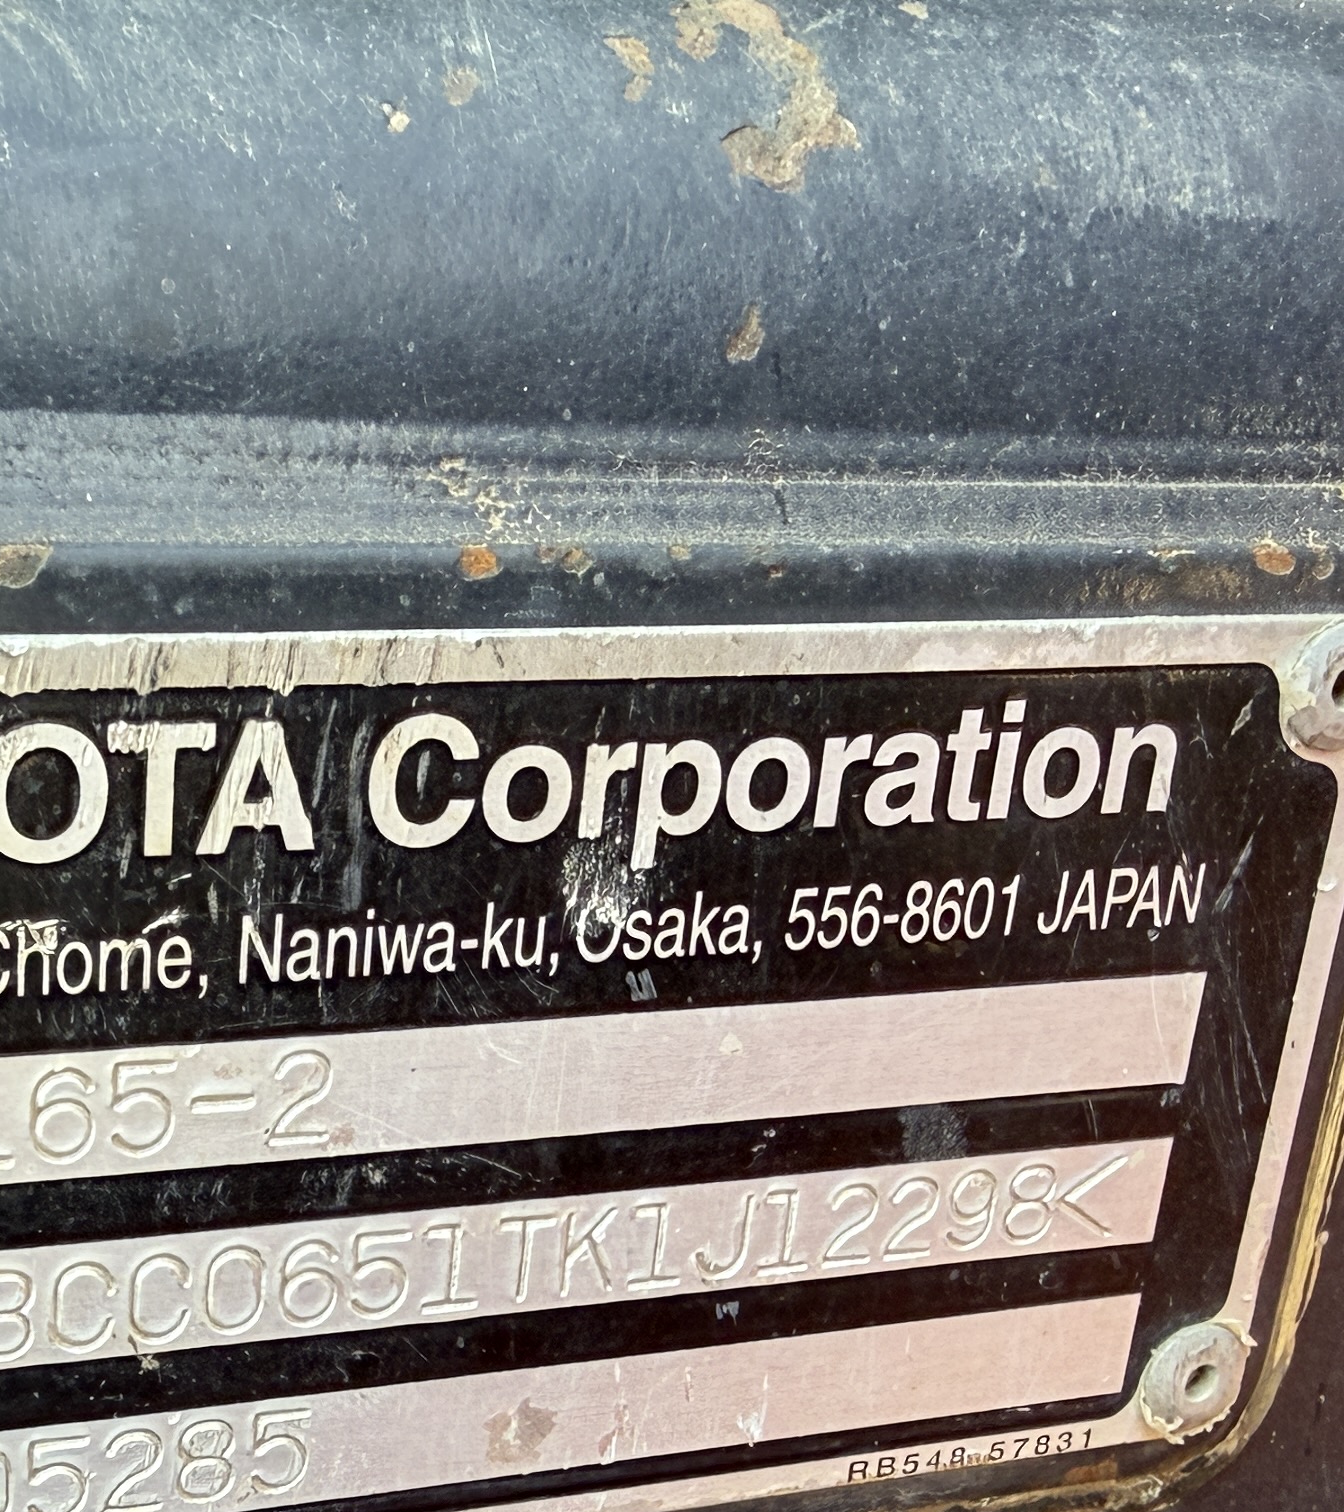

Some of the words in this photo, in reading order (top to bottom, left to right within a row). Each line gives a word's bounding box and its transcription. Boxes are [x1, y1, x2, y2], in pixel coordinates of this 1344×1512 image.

[368, 698, 1178, 871] Corporation
[238, 905, 560, 985] Naniwa-ku,
[576, 891, 762, 964] Osaka,
[785, 875, 1019, 953] 556-8601
[1037, 863, 1206, 937] JAPAN
